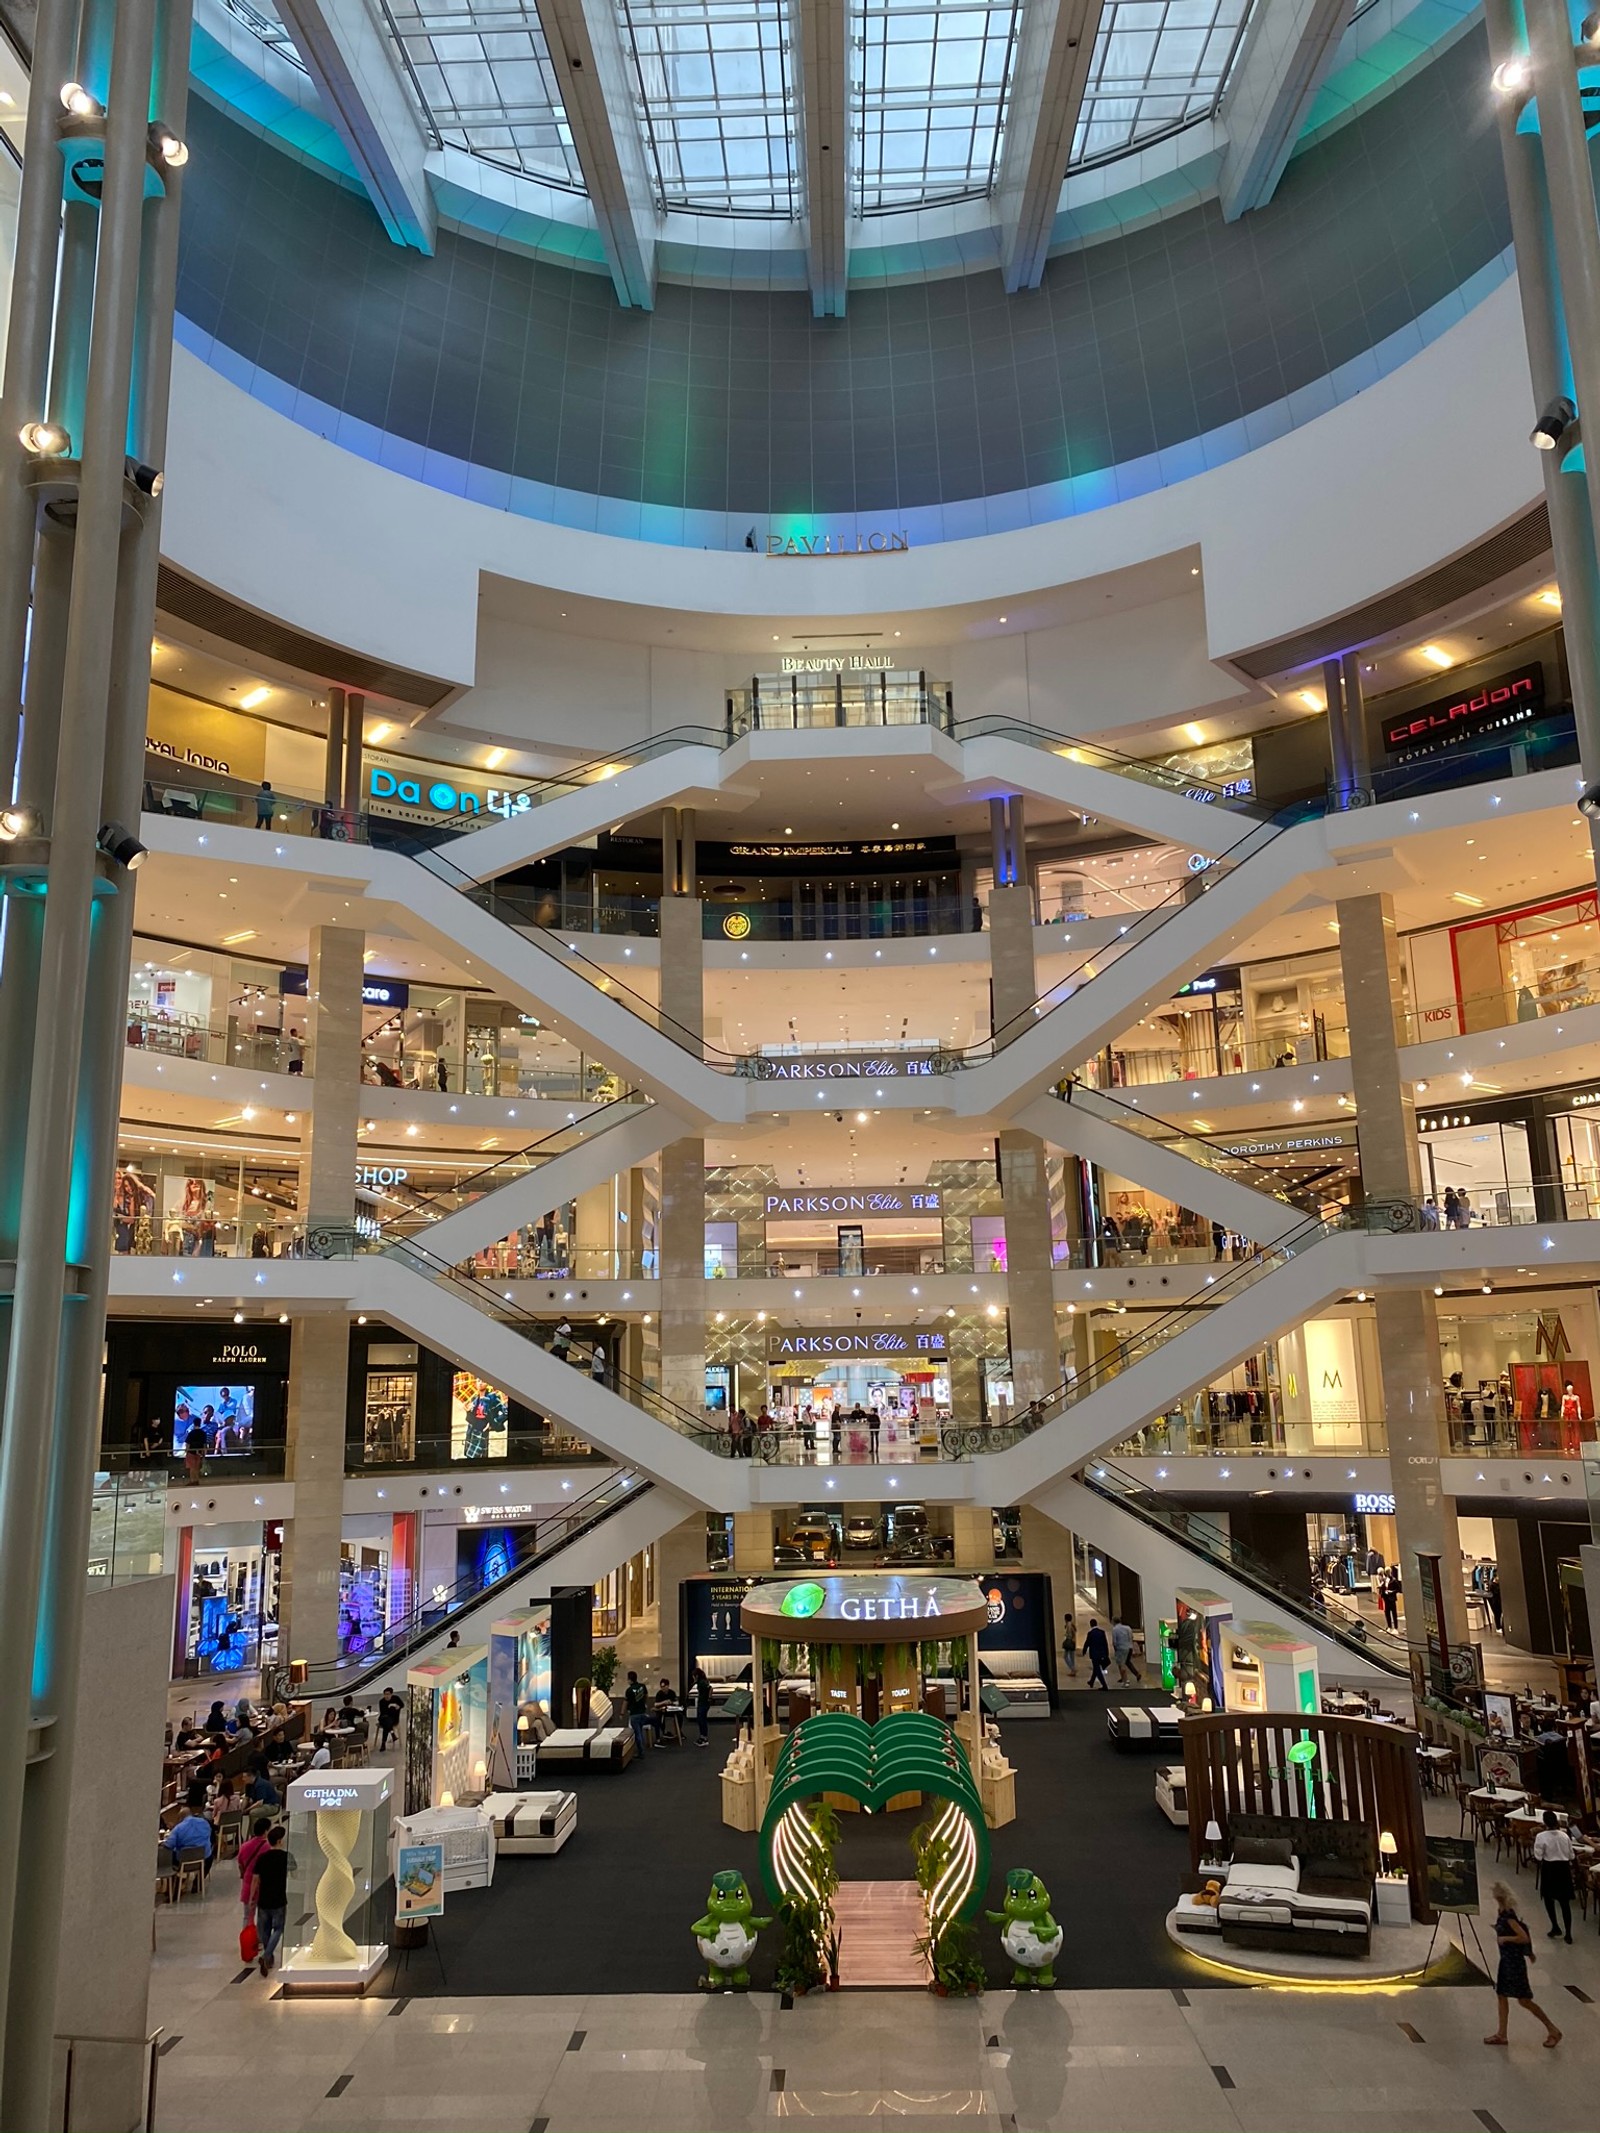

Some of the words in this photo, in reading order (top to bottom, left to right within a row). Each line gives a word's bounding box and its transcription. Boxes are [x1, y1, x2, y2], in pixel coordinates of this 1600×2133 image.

[766, 530, 909, 556] PAVILION
[782, 657, 844, 672] BEAUTY
[849, 656, 894, 670] HALL
[1398, 745, 1435, 763] ROYAL
[1442, 732, 1471, 747] THAI
[1478, 708, 1533, 733] CUISINE
[370, 768, 420, 804] Da
[429, 783, 480, 815] On
[371, 804, 392, 814] fine
[398, 811, 436, 823] korean
[730, 846, 783, 856] GRAND
[783, 846, 853, 856] IMPERIAL
[1424, 1008, 1451, 1023] KIDS
[862, 1060, 899, 1076] Elite
[1221, 1141, 1283, 1156] DOROTHY
[1286, 1135, 1343, 1149] PERKINS
[767, 1196, 865, 1213] PARKSON
[866, 1193, 904, 1210] Elite
[910, 1193, 940, 1209] 百盛
[222, 1345, 258, 1357] POLO
[769, 1335, 868, 1353] PARKSON
[870, 1333, 909, 1350] Elite
[915, 1333, 946, 1349] 百盛
[1355, 1493, 1396, 1509] BOSS
[480, 1505, 504, 1515] SWISS
[504, 1504, 532, 1513] WATCH
[830, 1689, 848, 1699] TASTE
[891, 1688, 910, 1698] TOUCH
[1268, 1766, 1338, 1784] GETHA
[304, 1789, 337, 1798] GETHA
[337, 1788, 358, 1797] DNA
